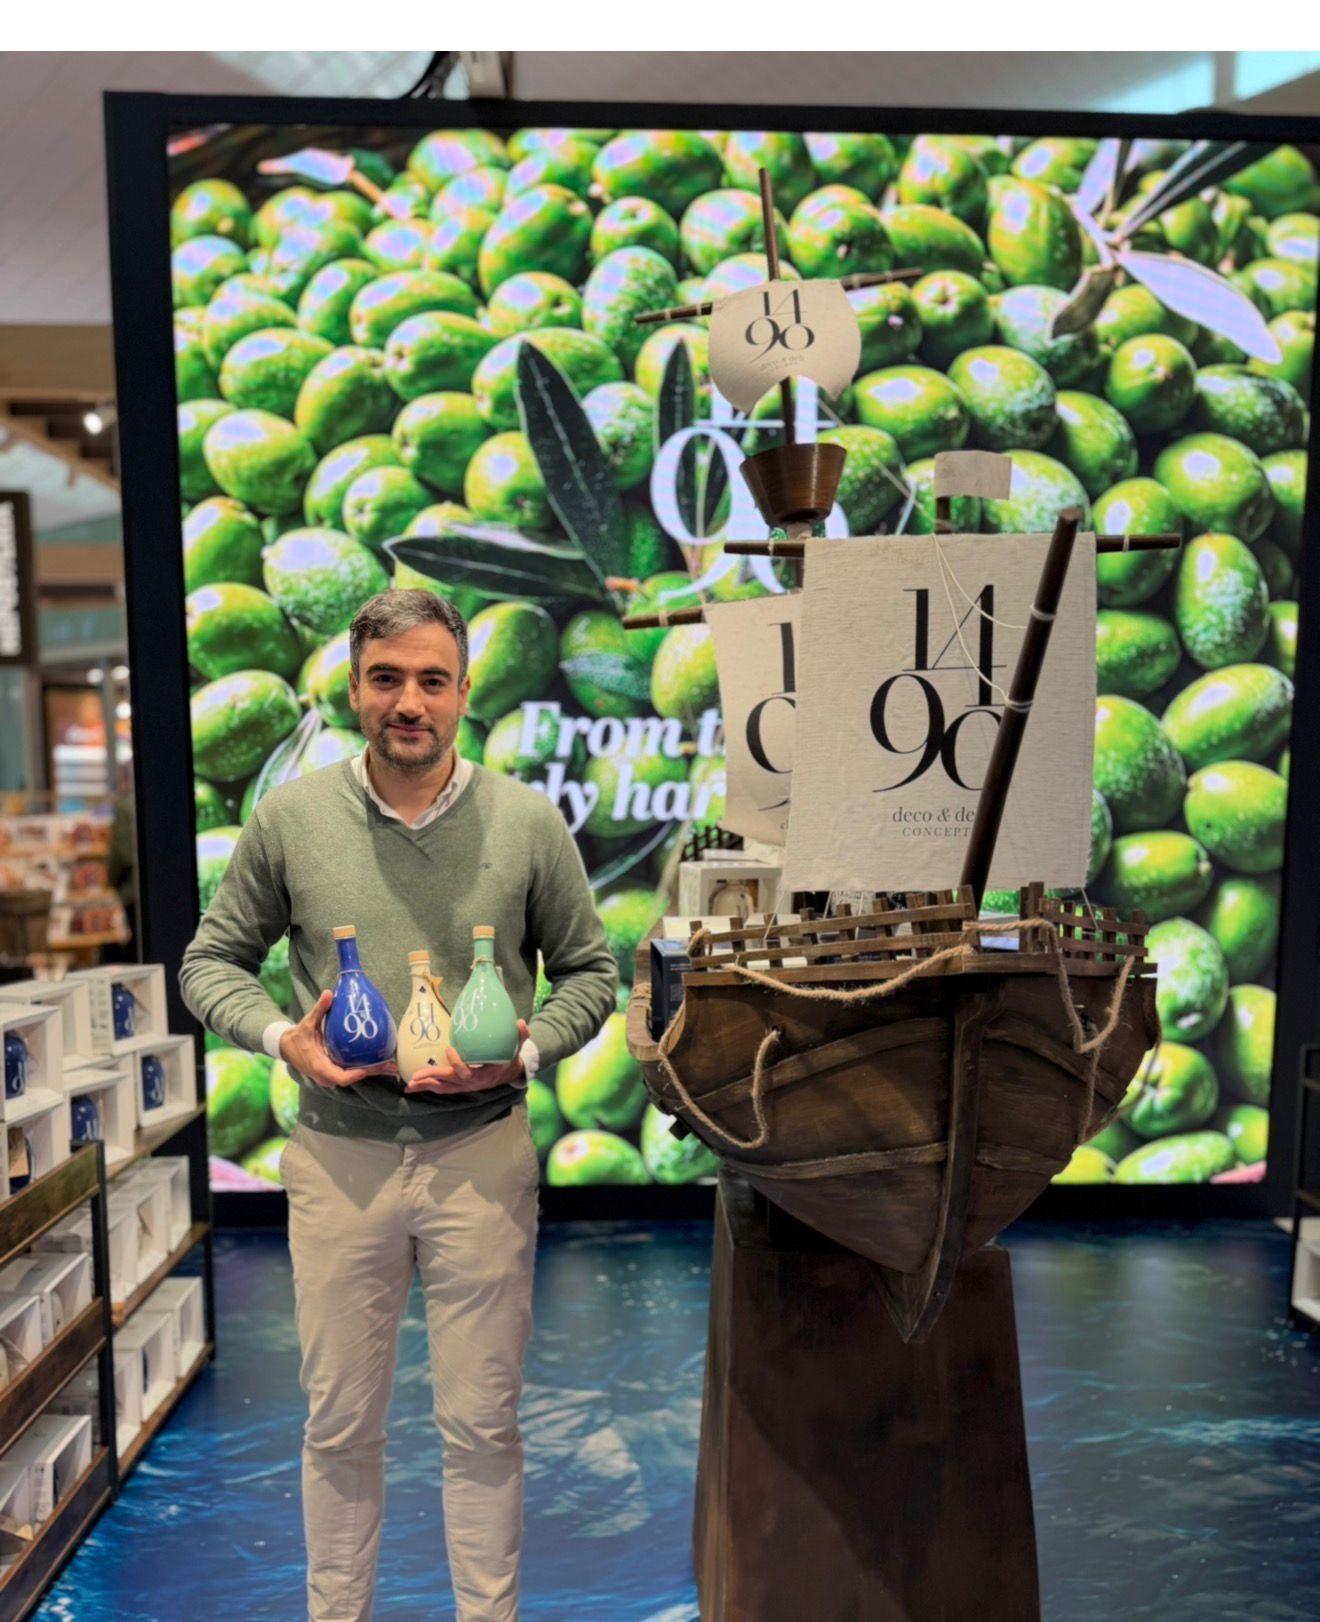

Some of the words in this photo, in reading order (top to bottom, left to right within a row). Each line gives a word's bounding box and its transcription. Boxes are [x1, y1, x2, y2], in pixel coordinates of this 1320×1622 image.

[758, 289, 807, 324] 14
[745, 316, 815, 363] 90
[768, 621, 796, 695] 1
[902, 584, 1007, 708] 14
[520, 701, 683, 758] From
[697, 708, 726, 757] t
[611, 762, 727, 822] har
[892, 806, 932, 822] deco
[937, 807, 951, 822] &
[955, 806, 975, 822] de
[343, 1012, 379, 1043] 90
